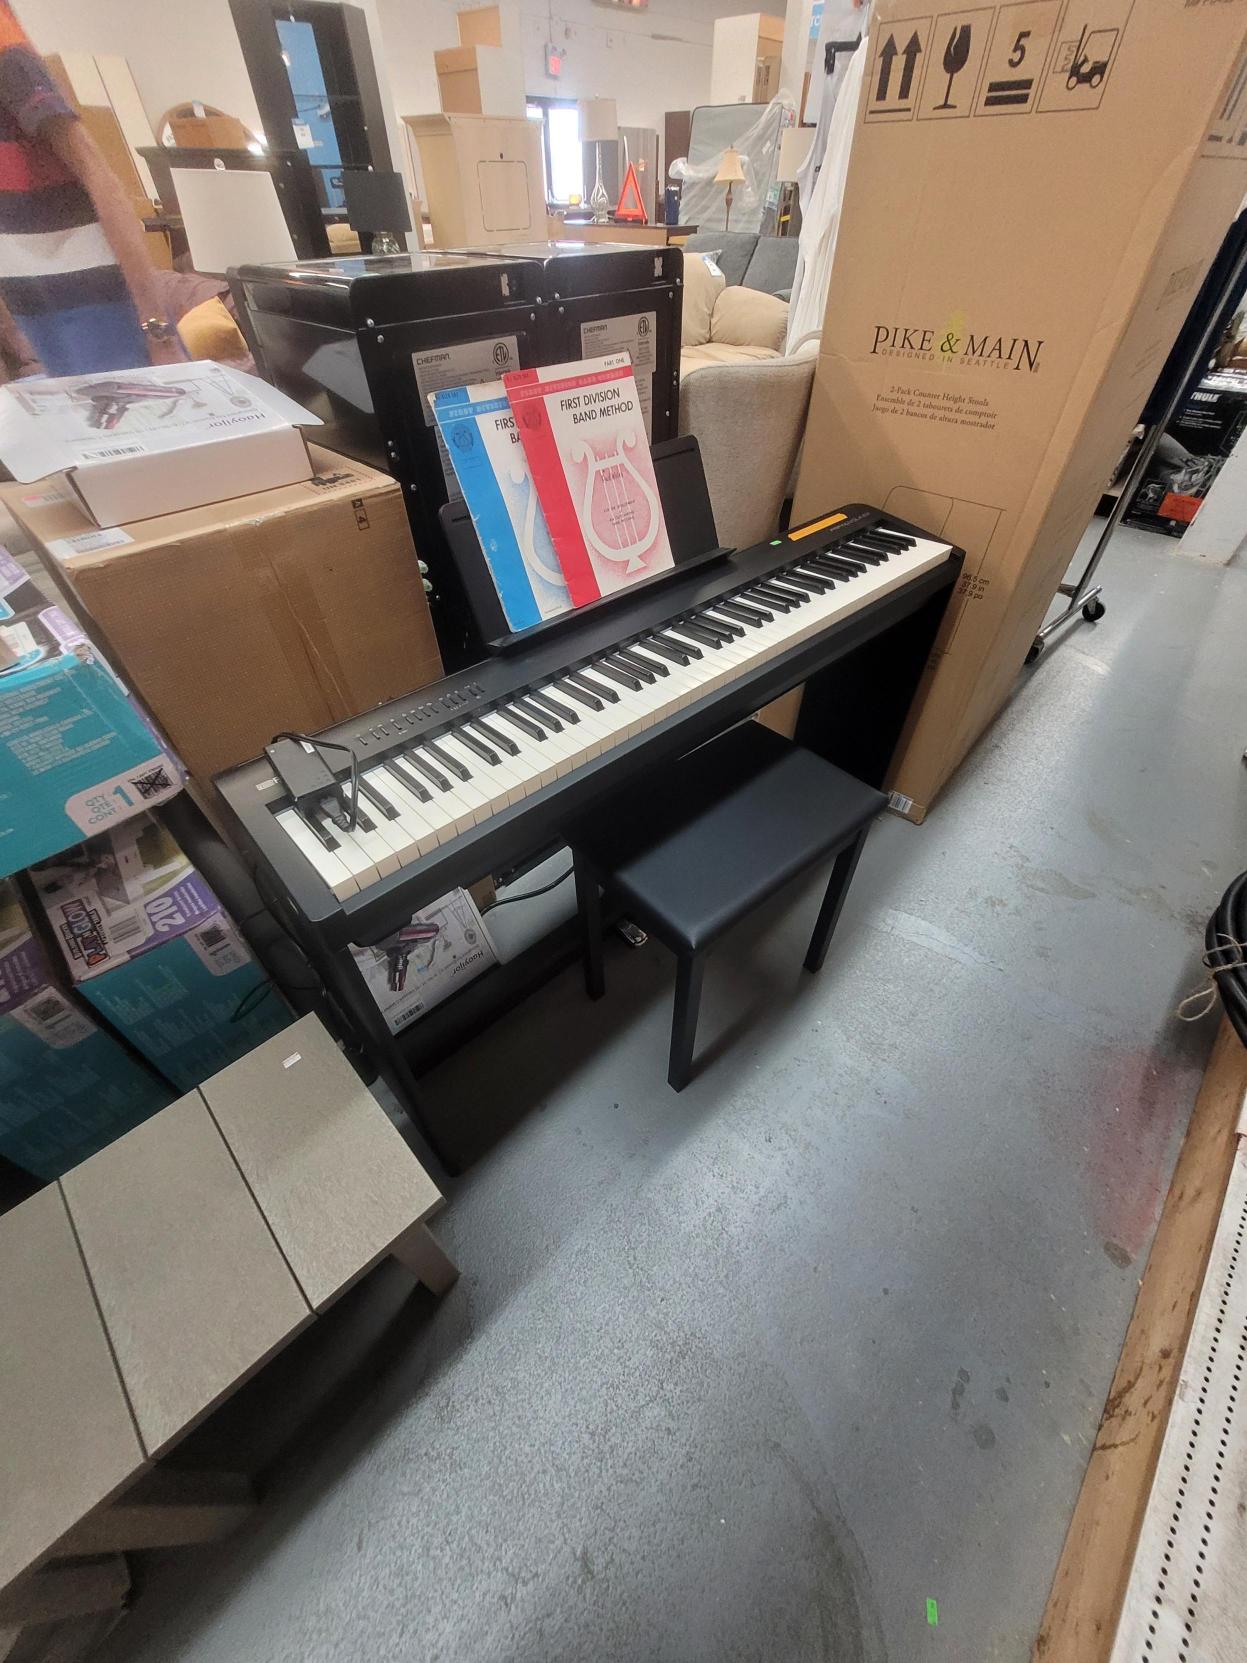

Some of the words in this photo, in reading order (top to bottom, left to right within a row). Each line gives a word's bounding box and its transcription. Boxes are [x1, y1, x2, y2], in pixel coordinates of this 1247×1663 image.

[1008, 30, 1031, 68] 5
[416, 352, 450, 364] CHEFMAN
[870, 326, 934, 354] PIKE
[940, 332, 960, 354] &
[964, 335, 1044, 372] MAIN
[882, 348, 935, 361] DESIGNED
[960, 358, 1010, 370] SEATTLE
[604, 358, 614, 367] PART
[615, 356, 625, 365] ONE
[560, 397, 582, 412] FIRST
[584, 388, 620, 406] DIVISION
[876, 394, 906, 404] Ensemble
[907, 398, 916, 406] de
[922, 401, 954, 413] tabourets
[954, 406, 964, 414] de
[965, 408, 997, 420] comptoir
[890, 386, 912, 396] 2-Pack
[913, 389, 941, 400] Counter
[942, 392, 967, 406] Height
[968, 396, 990, 407] Stools
[572, 410, 597, 425] BAND
[599, 400, 634, 421] METHOD
[872, 404, 890, 414] Juego
[906, 409, 928, 420] bancos
[929, 413, 938, 421] de
[938, 414, 959, 425] altura
[960, 417, 996, 430] mostrador
[962, 572, 978, 582] 96.5
[112, 784, 134, 807] 1
[145, 896, 186, 932] 210
